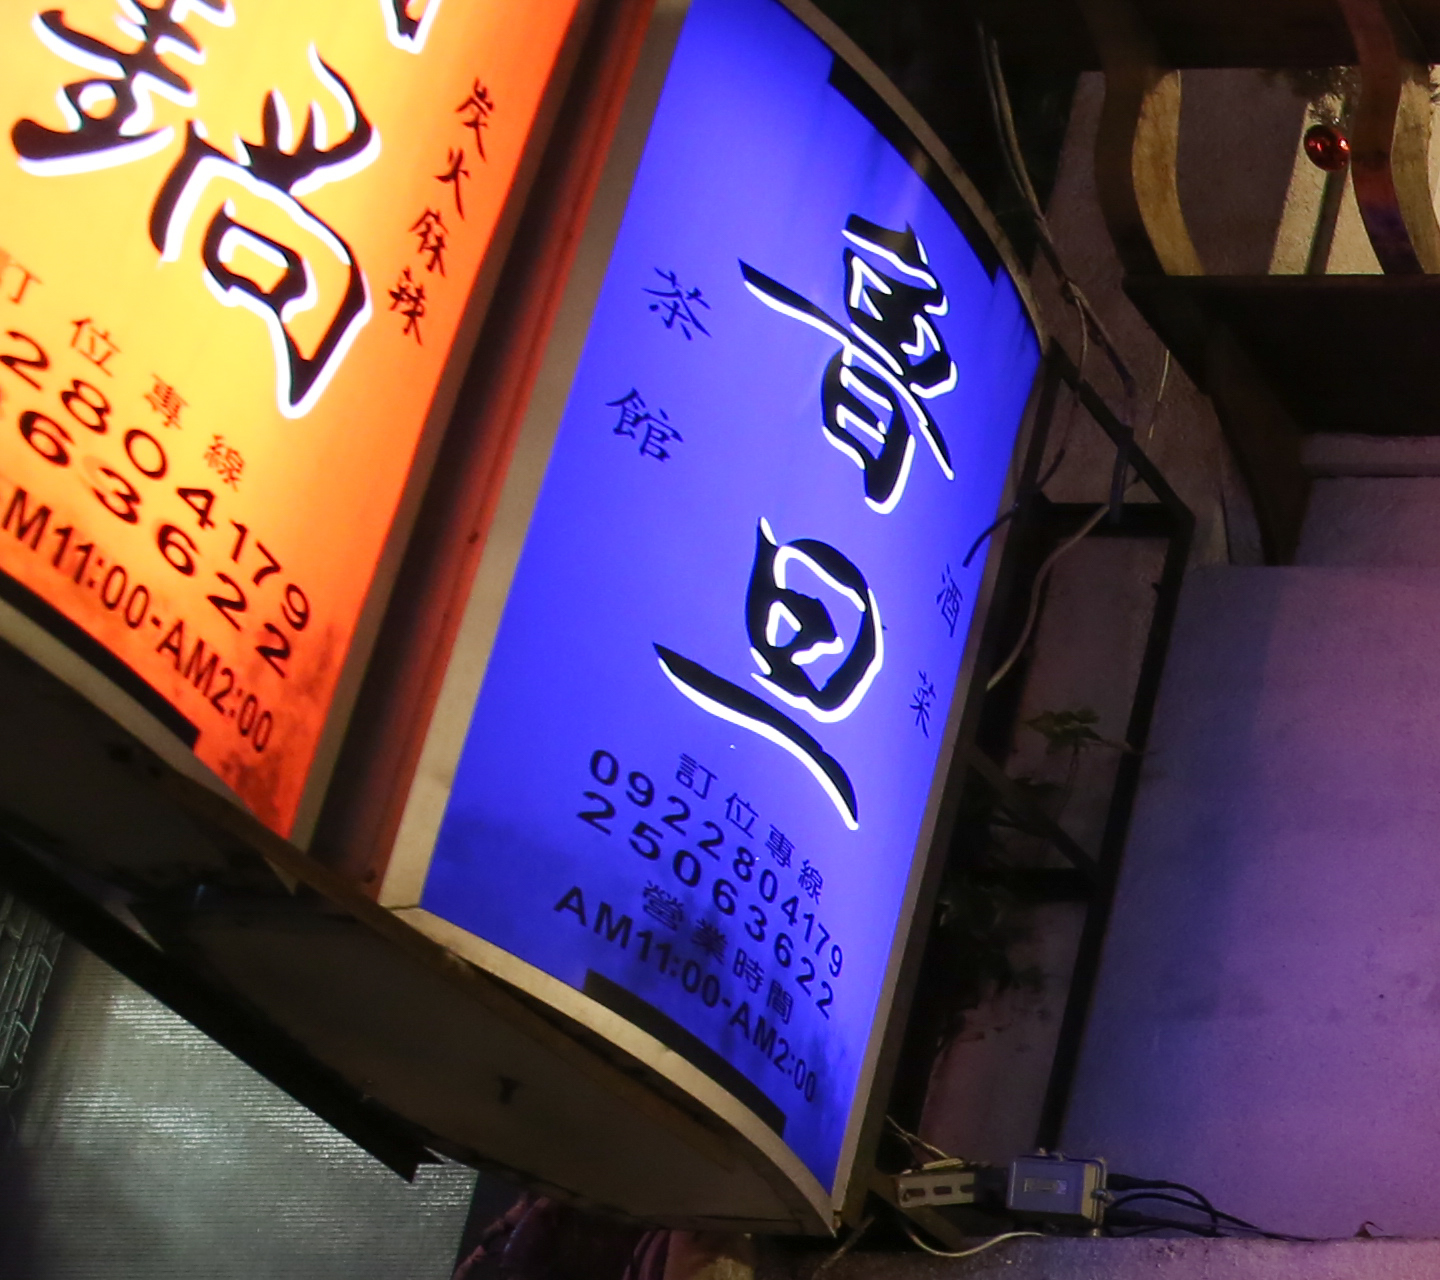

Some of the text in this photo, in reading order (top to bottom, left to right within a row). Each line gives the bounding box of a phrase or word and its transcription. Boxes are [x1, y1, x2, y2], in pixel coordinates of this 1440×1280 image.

[577, 794, 834, 1019] 25063622
[588, 748, 844, 980] 0922804179
[680, 752, 824, 900] 訂位專線
[554, 884, 819, 1105] AM11:00-AM2:00
[642, 878, 798, 1024] 營業時間
